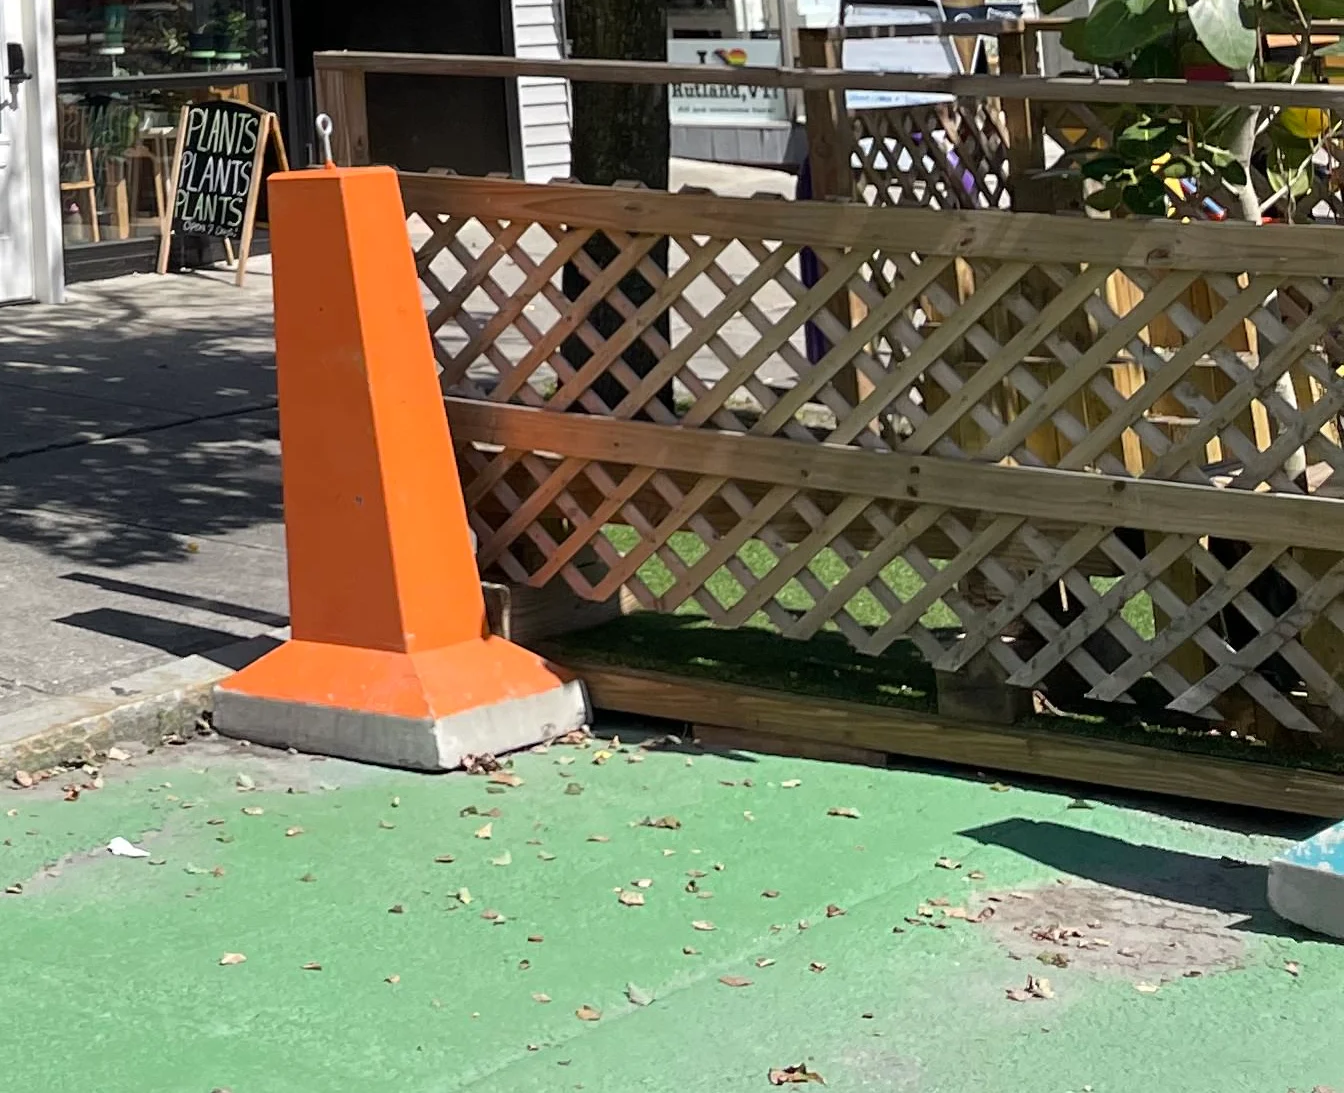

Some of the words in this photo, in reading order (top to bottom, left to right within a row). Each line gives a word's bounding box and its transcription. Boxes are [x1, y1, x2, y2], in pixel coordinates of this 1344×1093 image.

[185, 107, 259, 156] PLANTS
[179, 151, 253, 197] PLANTS
[175, 189, 243, 227] PLANTS
